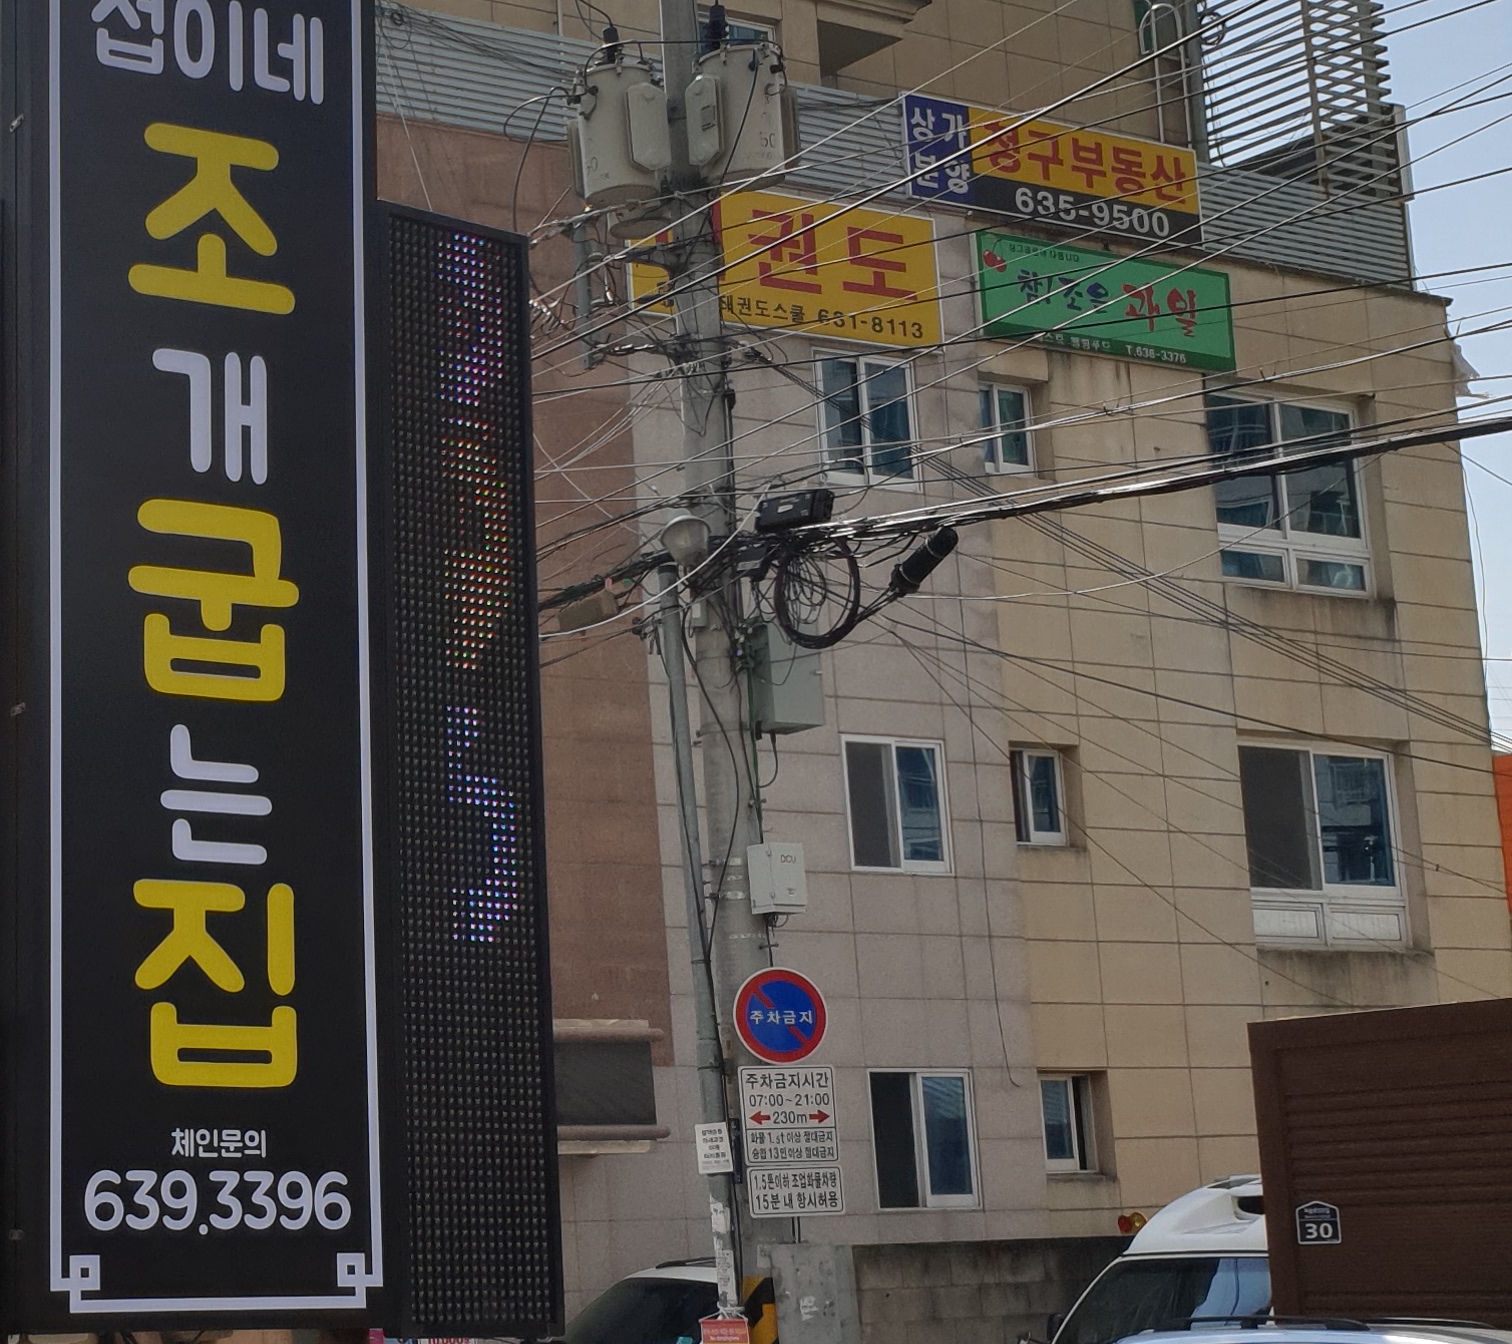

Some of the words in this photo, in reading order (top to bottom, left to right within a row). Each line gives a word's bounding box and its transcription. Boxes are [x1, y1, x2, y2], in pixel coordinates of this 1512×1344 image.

[910, 107, 967, 149] 상가
[910, 151, 972, 195] 분양
[1014, 187, 1170, 237] 635-9500
[817, 307, 925, 340] 631-8113
[1121, 282, 1198, 338] 과일
[127, 122, 300, 1088] 조개굽는집
[749, 1009, 813, 1025] 주차금지
[745, 1071, 830, 1090] 주차금지시간
[772, 1110, 808, 1124] 230m
[171, 1127, 268, 1159] 체인문의
[84, 1168, 353, 1236] 639.3396
[1305, 1222, 1334, 1239] 30
